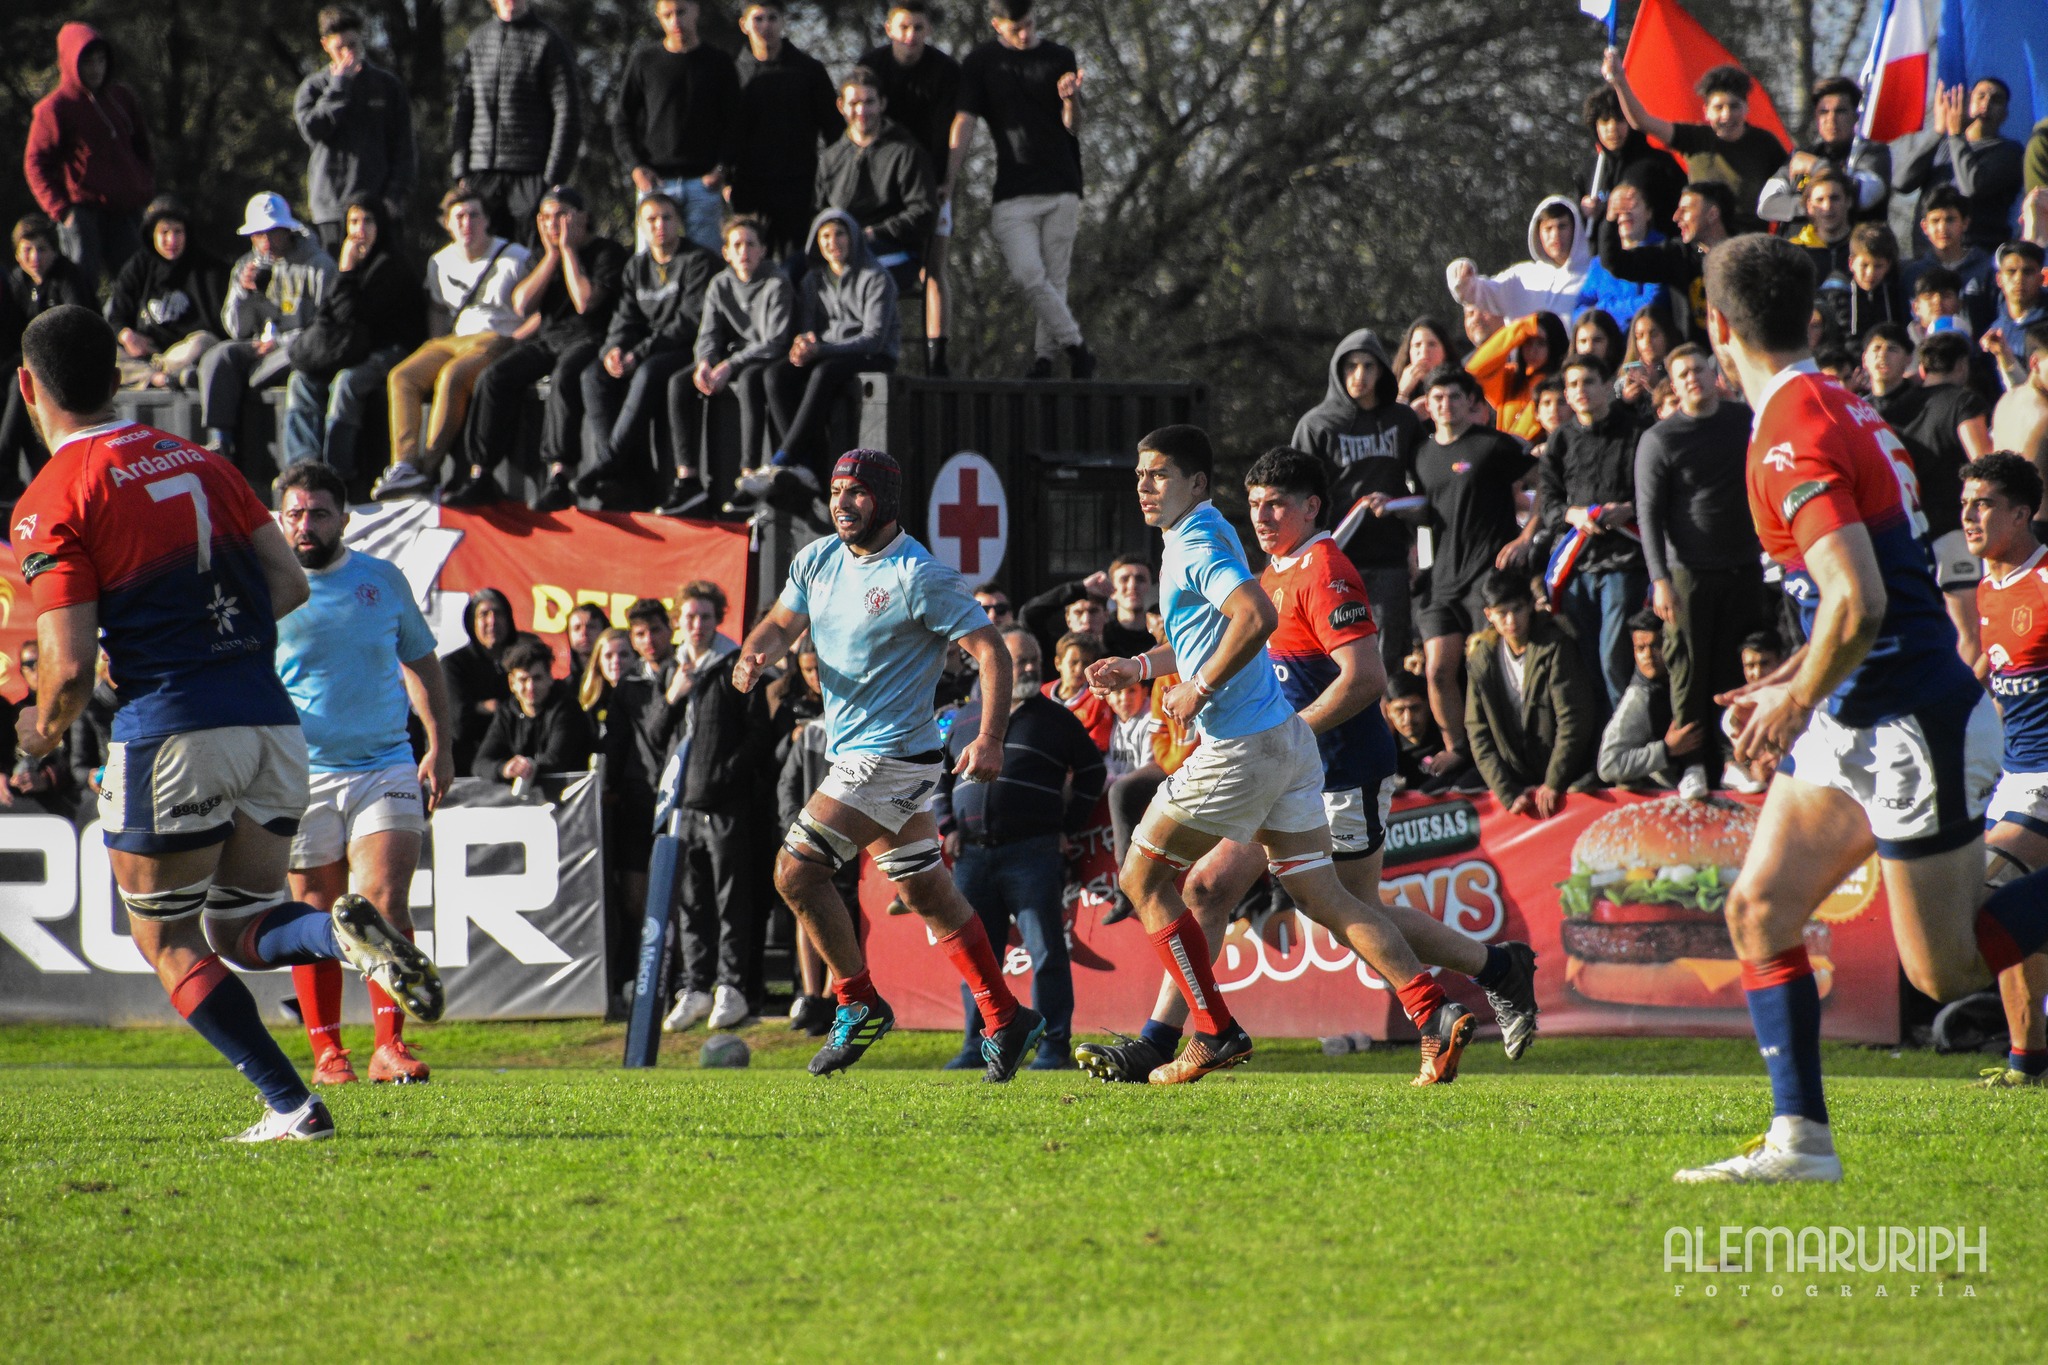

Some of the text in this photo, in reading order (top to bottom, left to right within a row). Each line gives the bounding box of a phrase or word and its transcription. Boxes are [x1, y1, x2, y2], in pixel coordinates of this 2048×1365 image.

[1338, 425, 1398, 467] EVERLAST
[109, 448, 205, 488] Ardama
[143, 472, 214, 574] 7
